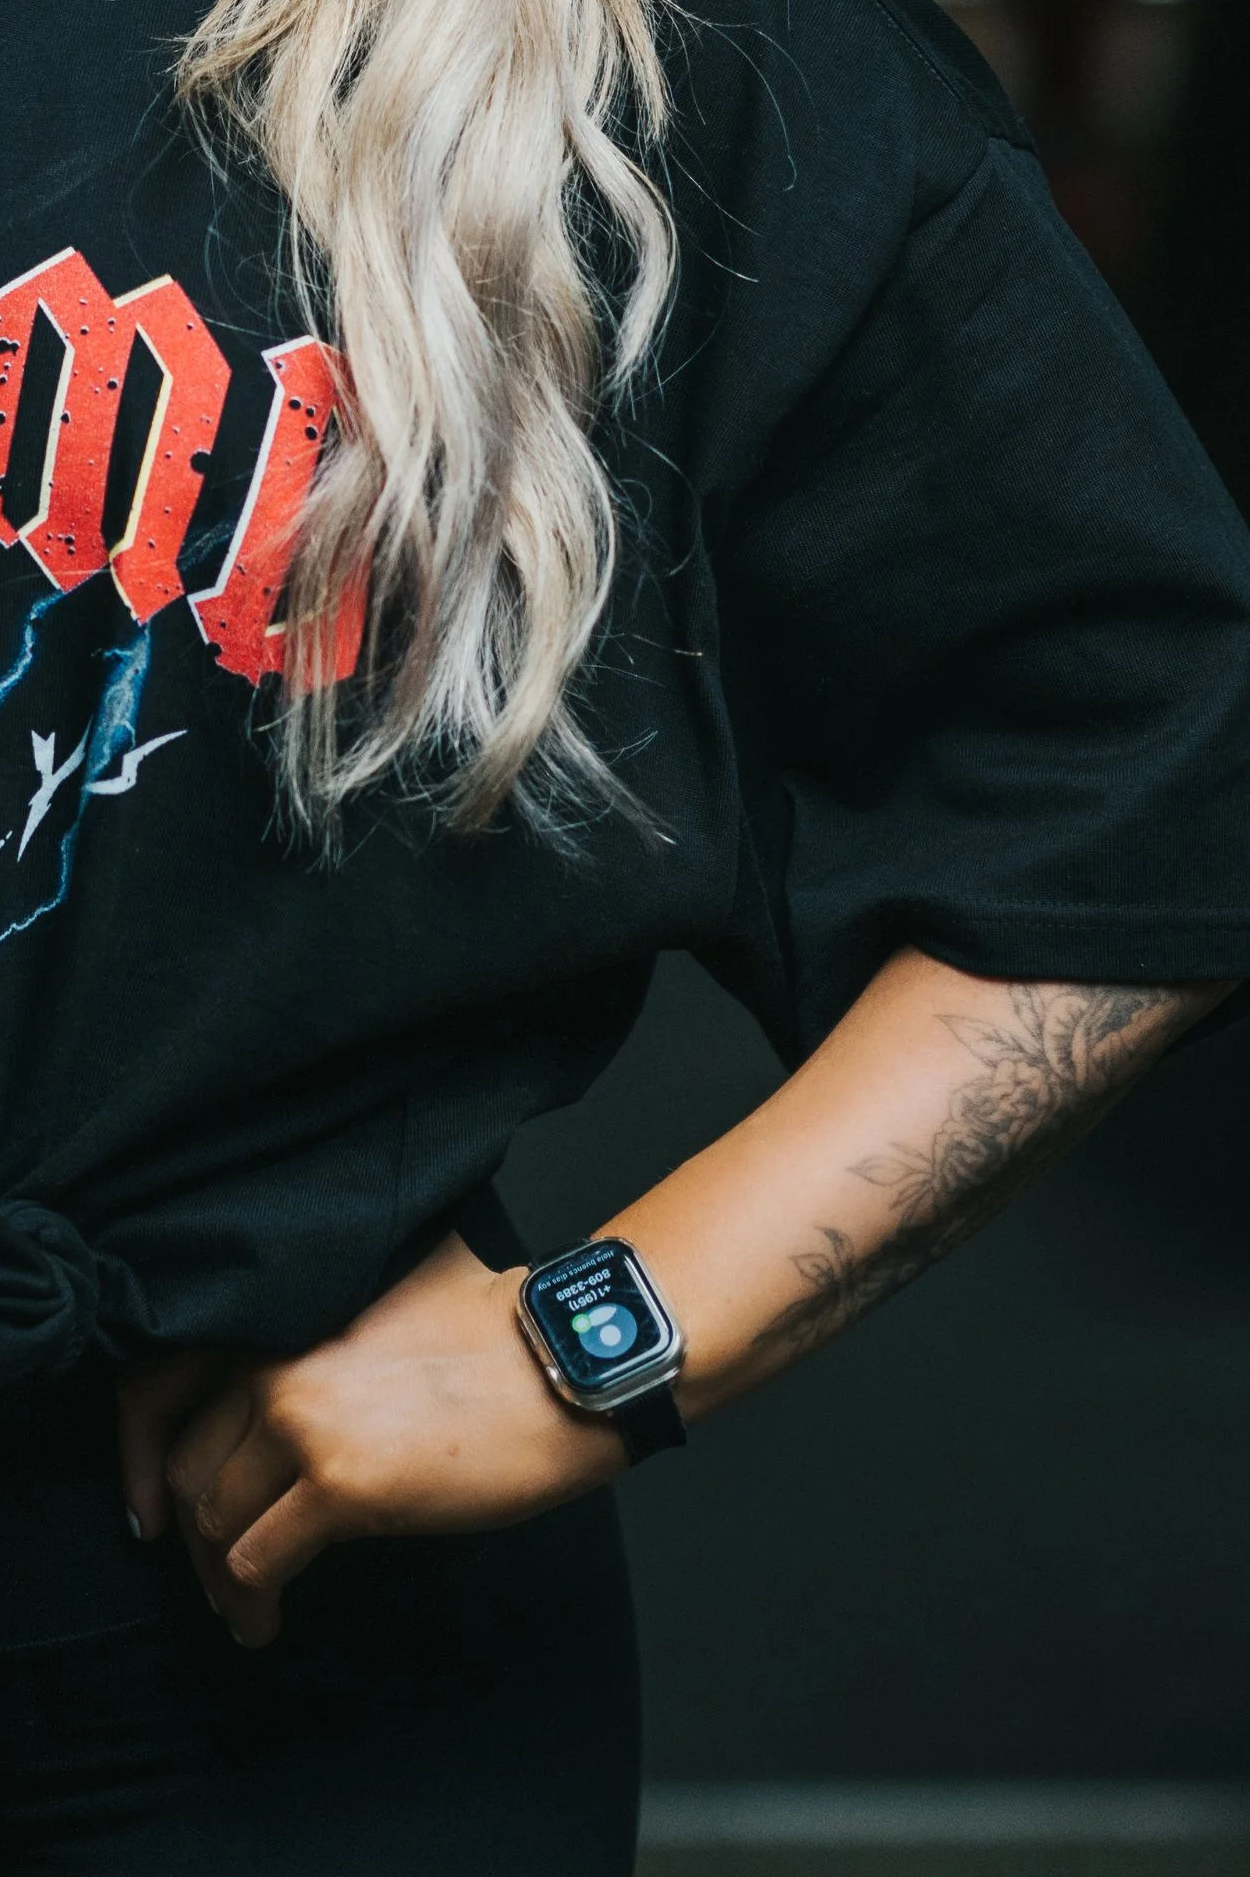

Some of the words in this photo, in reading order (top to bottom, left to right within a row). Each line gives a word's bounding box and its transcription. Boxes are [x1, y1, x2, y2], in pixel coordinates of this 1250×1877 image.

[596, 1249, 615, 1261] Hola
[537, 1281, 552, 1292] soy
[556, 1268, 611, 1302] 809-3389
[597, 1284, 611, 1298] +1
